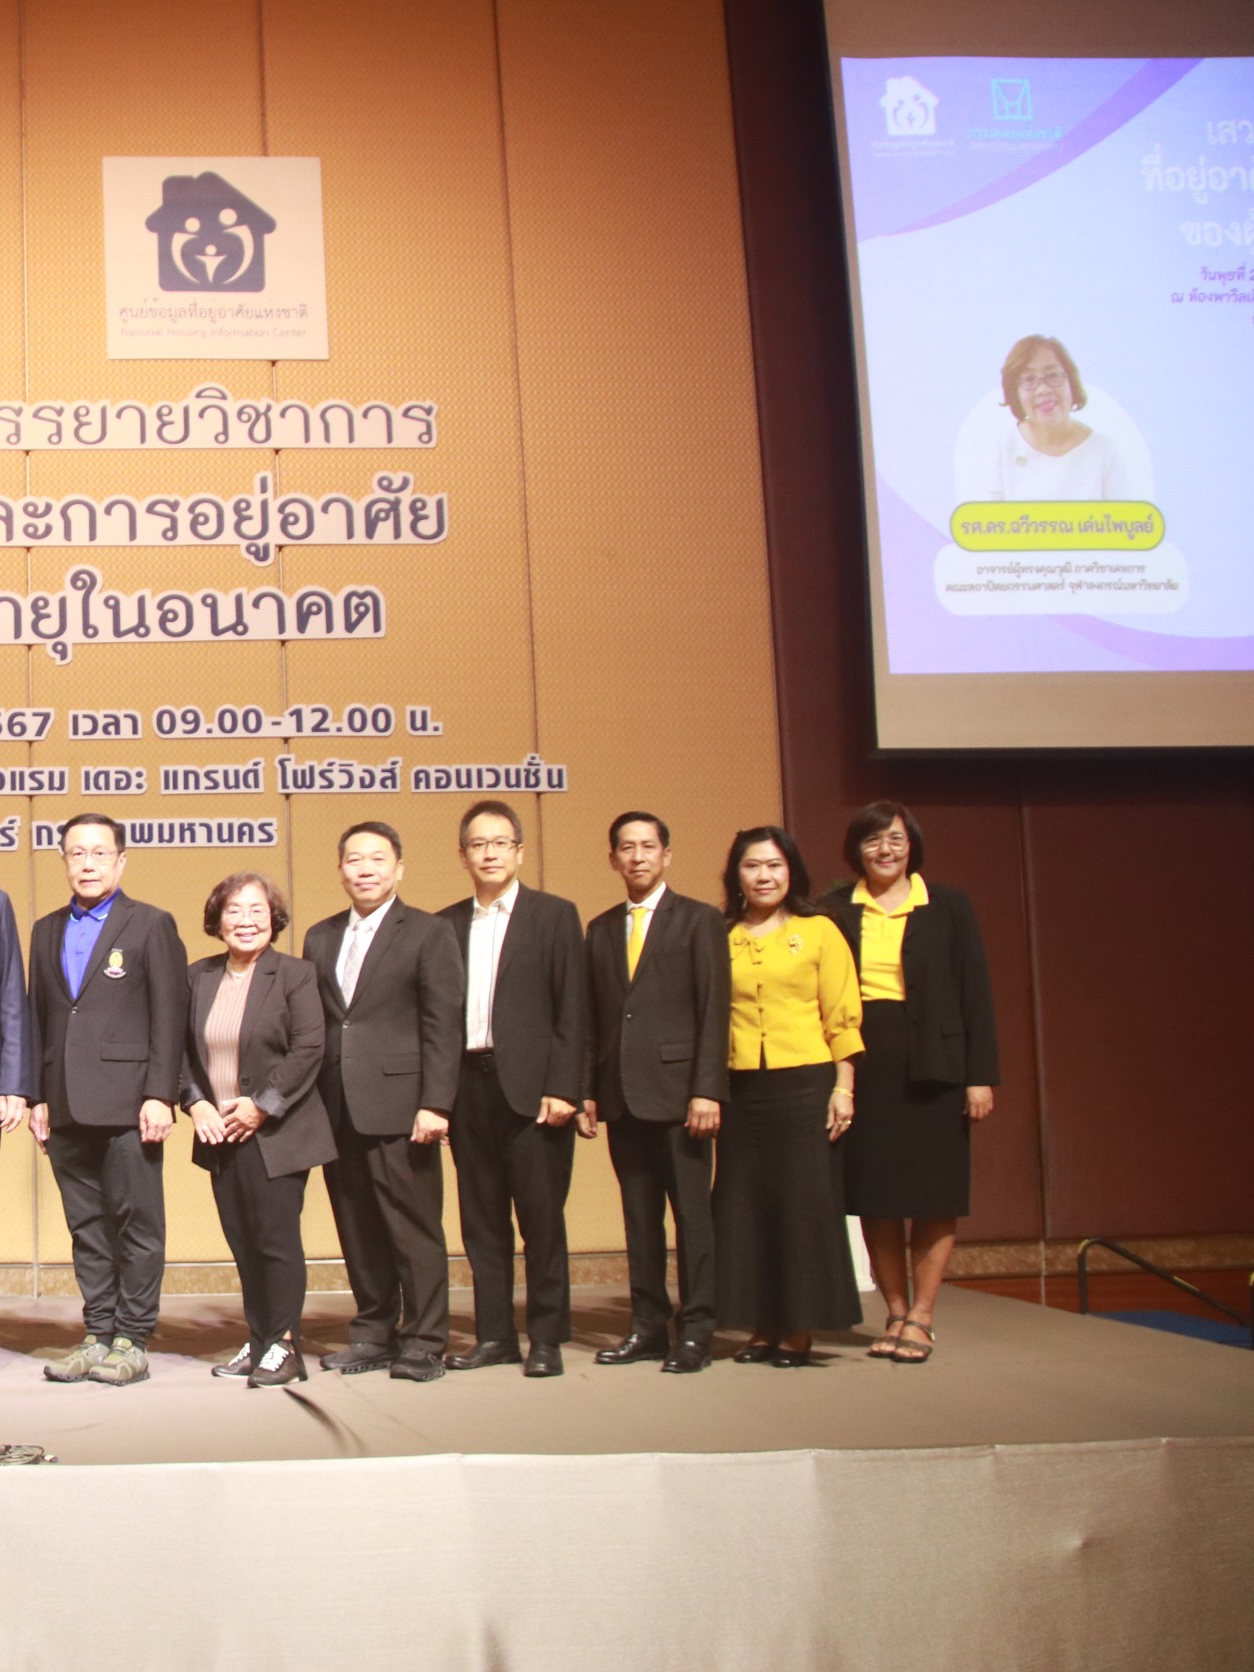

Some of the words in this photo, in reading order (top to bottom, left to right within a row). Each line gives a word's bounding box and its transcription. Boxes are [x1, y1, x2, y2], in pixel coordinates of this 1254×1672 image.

[1140, 143, 1254, 205] ที่อยู่อา
[119, 297, 308, 324] ศูนย์ข้อมูลที่อยู่อาศัยแห่งชาติ
[121, 327, 163, 337] National
[167, 327, 207, 339] Housing
[210, 327, 269, 338] Information
[272, 327, 306, 337] Center
[72, 713, 139, 736] เวลา
[156, 708, 392, 735] 09.00-12.00
[410, 710, 441, 732] น.
[84, 771, 144, 791] เดอะ
[163, 761, 261, 791] แกรนด์
[278, 758, 398, 790] โฟร์วิงส์
[414, 756, 564, 790] คอนเวนชั่น
